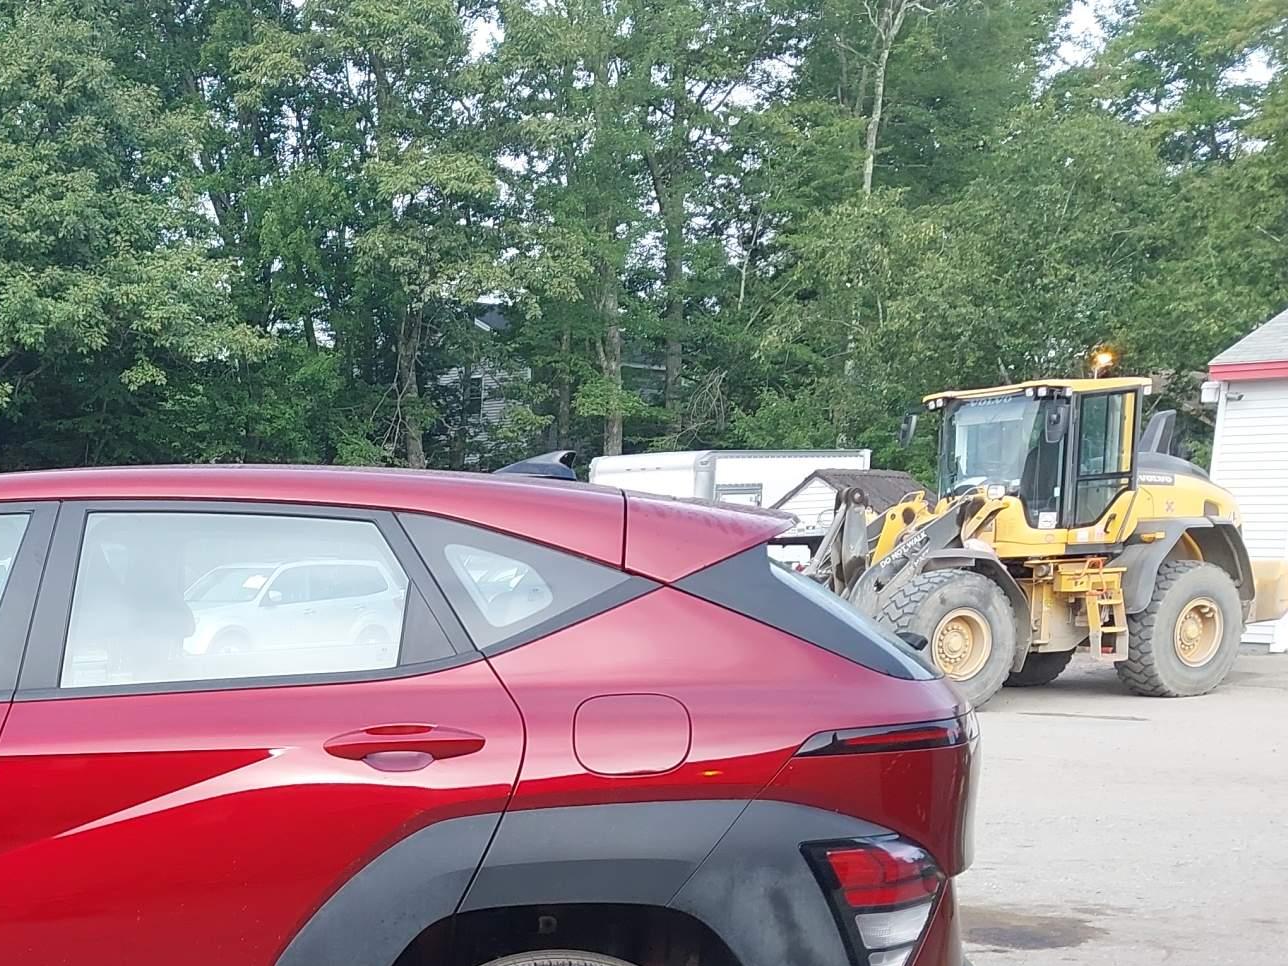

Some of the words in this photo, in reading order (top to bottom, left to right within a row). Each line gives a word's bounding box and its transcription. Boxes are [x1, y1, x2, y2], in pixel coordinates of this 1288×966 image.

[1138, 474, 1173, 483] VOLVO
[879, 556, 892, 568] DO
[892, 544, 909, 561] NOT
[907, 530, 928, 550] WALK
